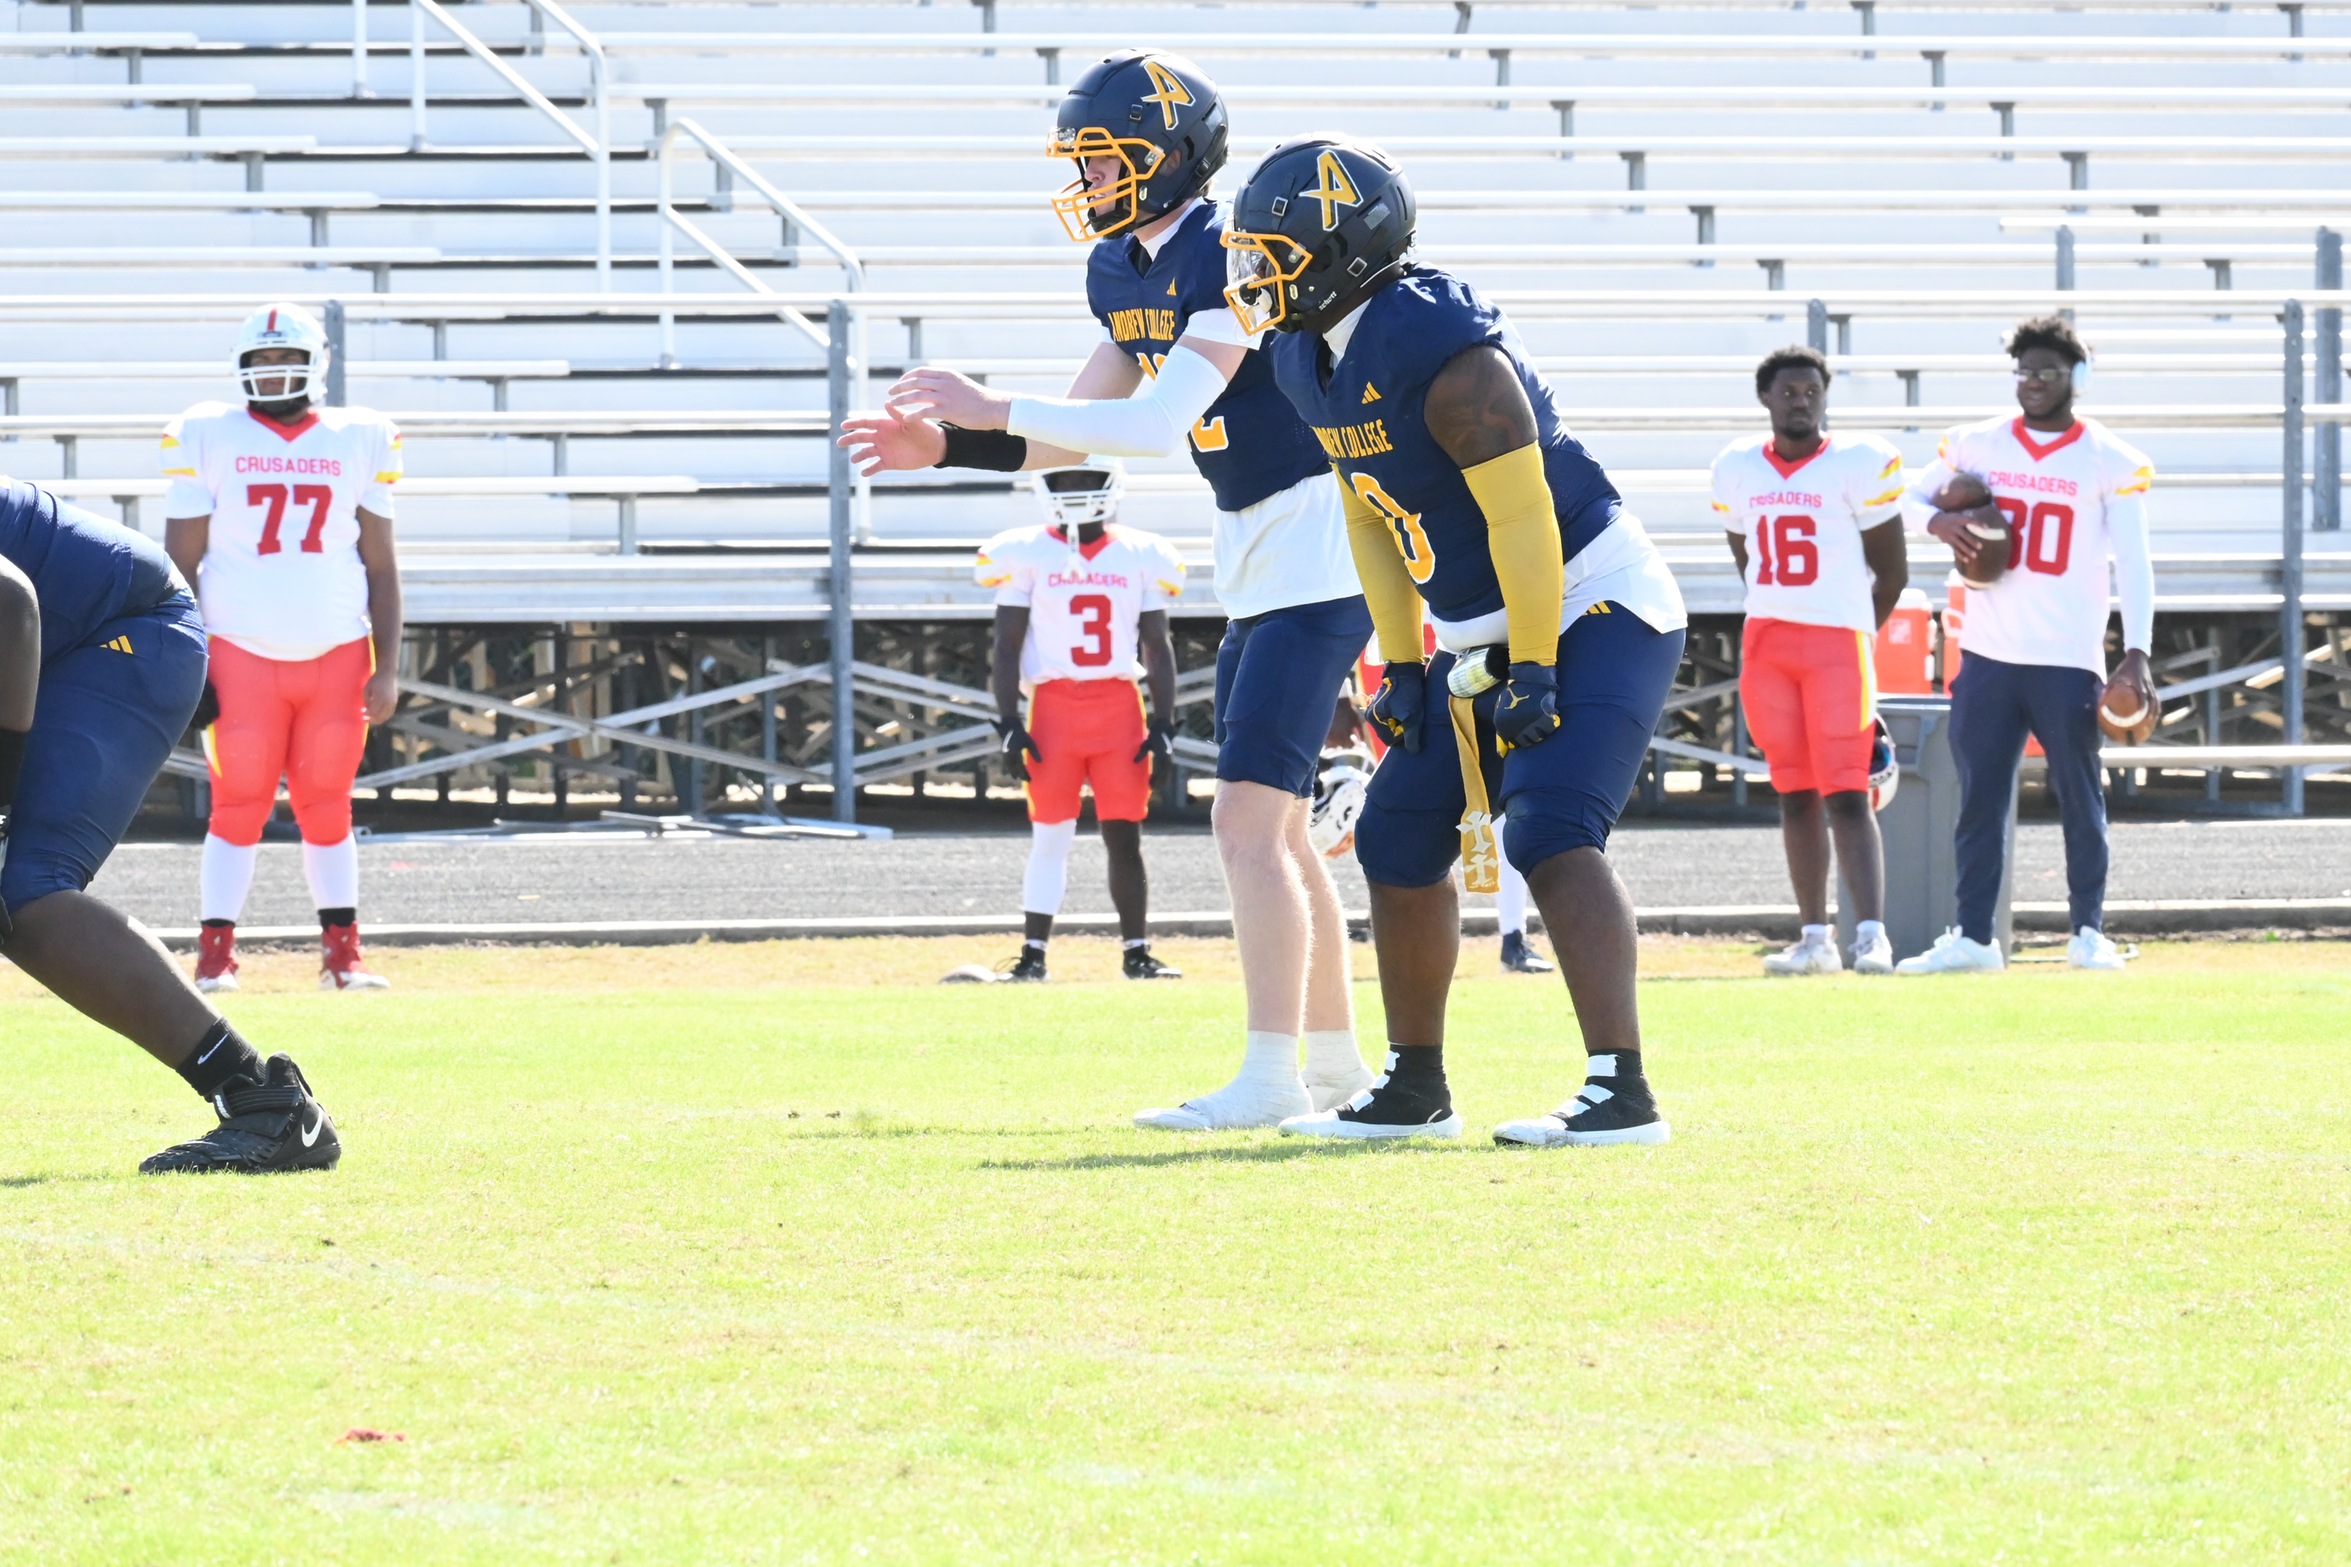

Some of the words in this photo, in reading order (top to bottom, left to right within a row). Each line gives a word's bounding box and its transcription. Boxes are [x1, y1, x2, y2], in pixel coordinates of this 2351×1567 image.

[1107, 308, 1146, 343] ANDREW
[1145, 308, 1176, 341] COLLEGE
[1340, 418, 1394, 459] COLLEGE
[235, 456, 342, 477] CRUSADERS
[1986, 470, 2078, 497] CRUSADERS
[246, 483, 333, 556] 77
[1756, 515, 1819, 587] 16
[1069, 594, 1113, 667] 3
